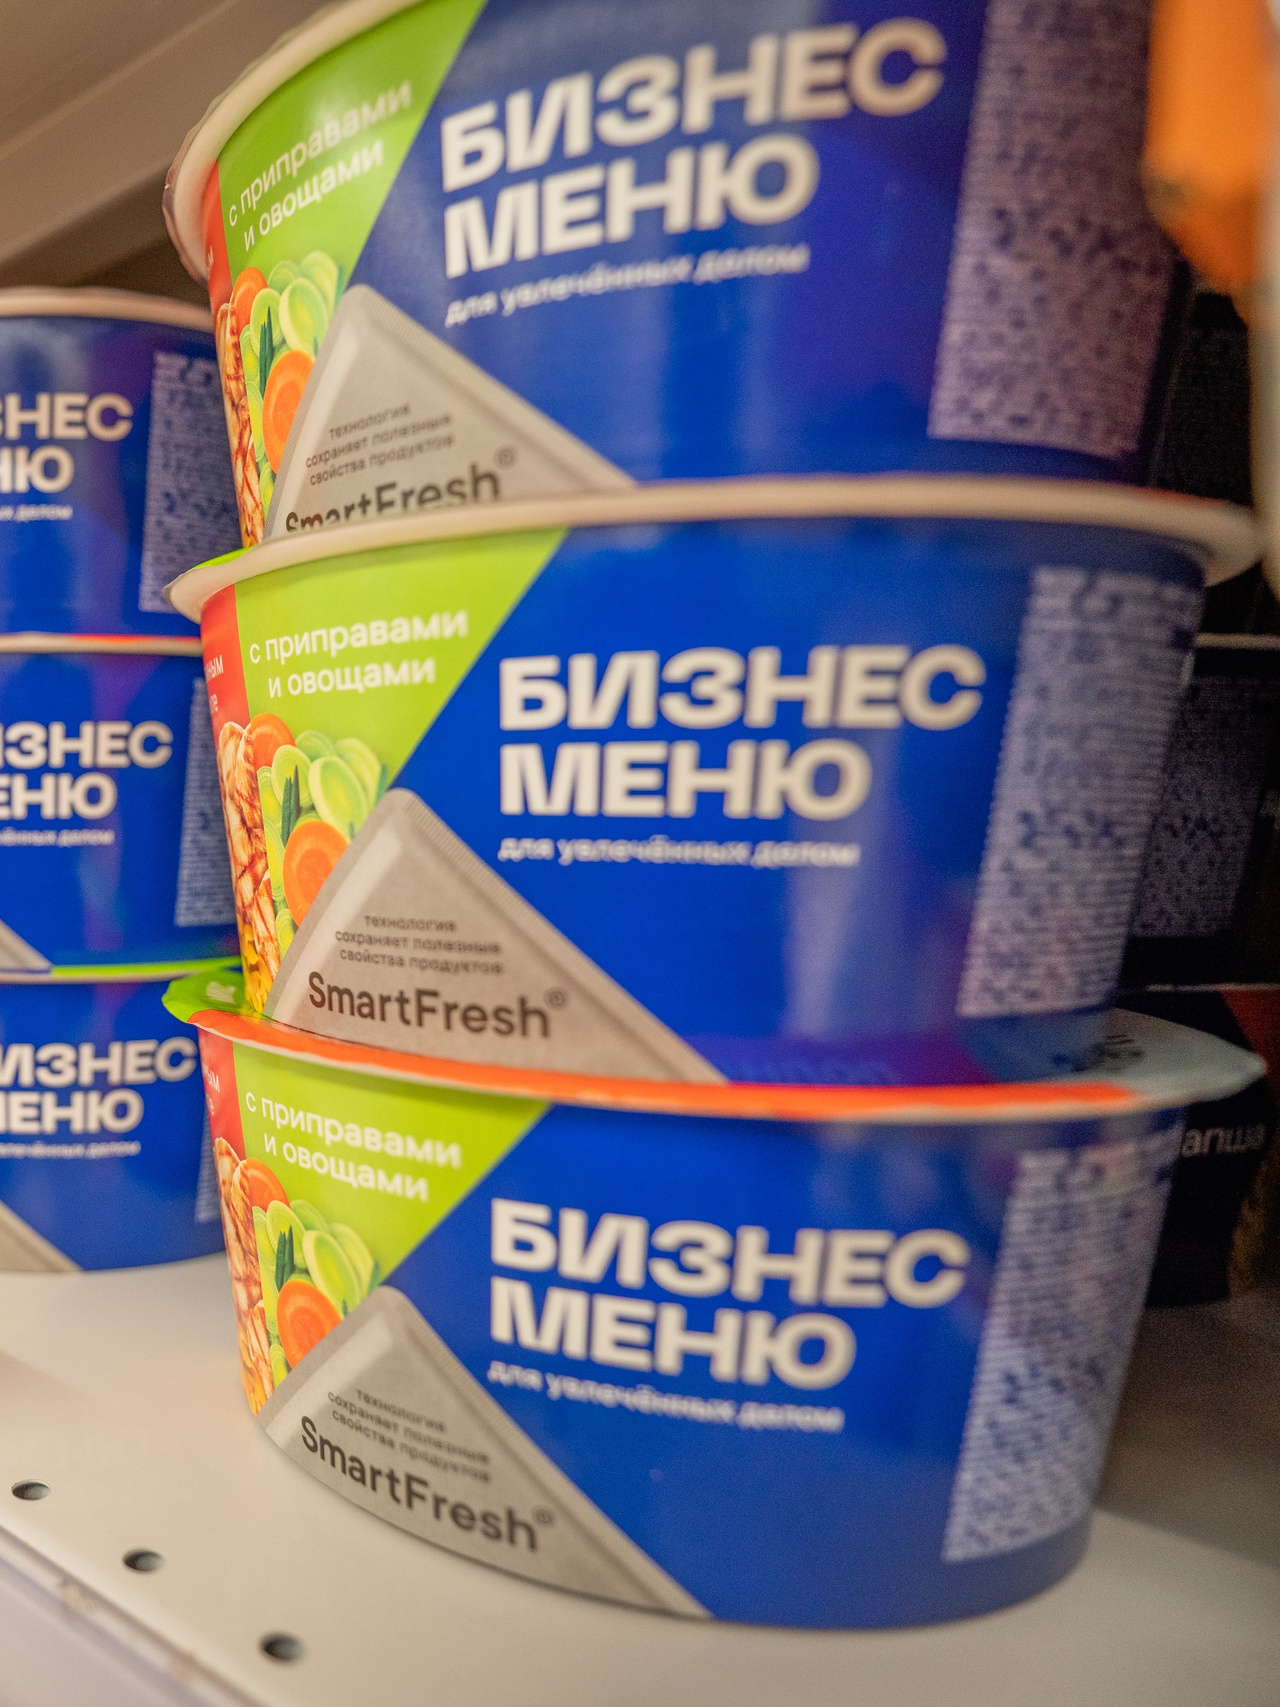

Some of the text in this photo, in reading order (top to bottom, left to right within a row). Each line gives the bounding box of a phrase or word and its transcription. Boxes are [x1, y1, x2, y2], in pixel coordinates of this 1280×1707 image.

[440, 16, 949, 193] БИЗНЕС
[229, 79, 412, 227] с приправами
[244, 139, 384, 253] и овощами
[442, 132, 819, 280] МЕНЮ
[249, 610, 468, 665] с приправами
[268, 657, 436, 699] и овощами
[498, 643, 987, 731] БИЗНЕС
[499, 737, 873, 821] МЕНЮ
[497, 838, 554, 862] для
[335, 930, 408, 950] сохраняет
[339, 948, 406, 968] свойства
[363, 915, 457, 933] технология
[245, 1091, 256, 1113] с
[261, 1097, 462, 1169] приправами
[263, 1132, 429, 1202] и овощами
[1181, 1124, 1265, 1158] апша
[490, 1197, 971, 1309] БИЗНЕС
[489, 1275, 857, 1391] МЕНЮ
[487, 1360, 543, 1391] для
